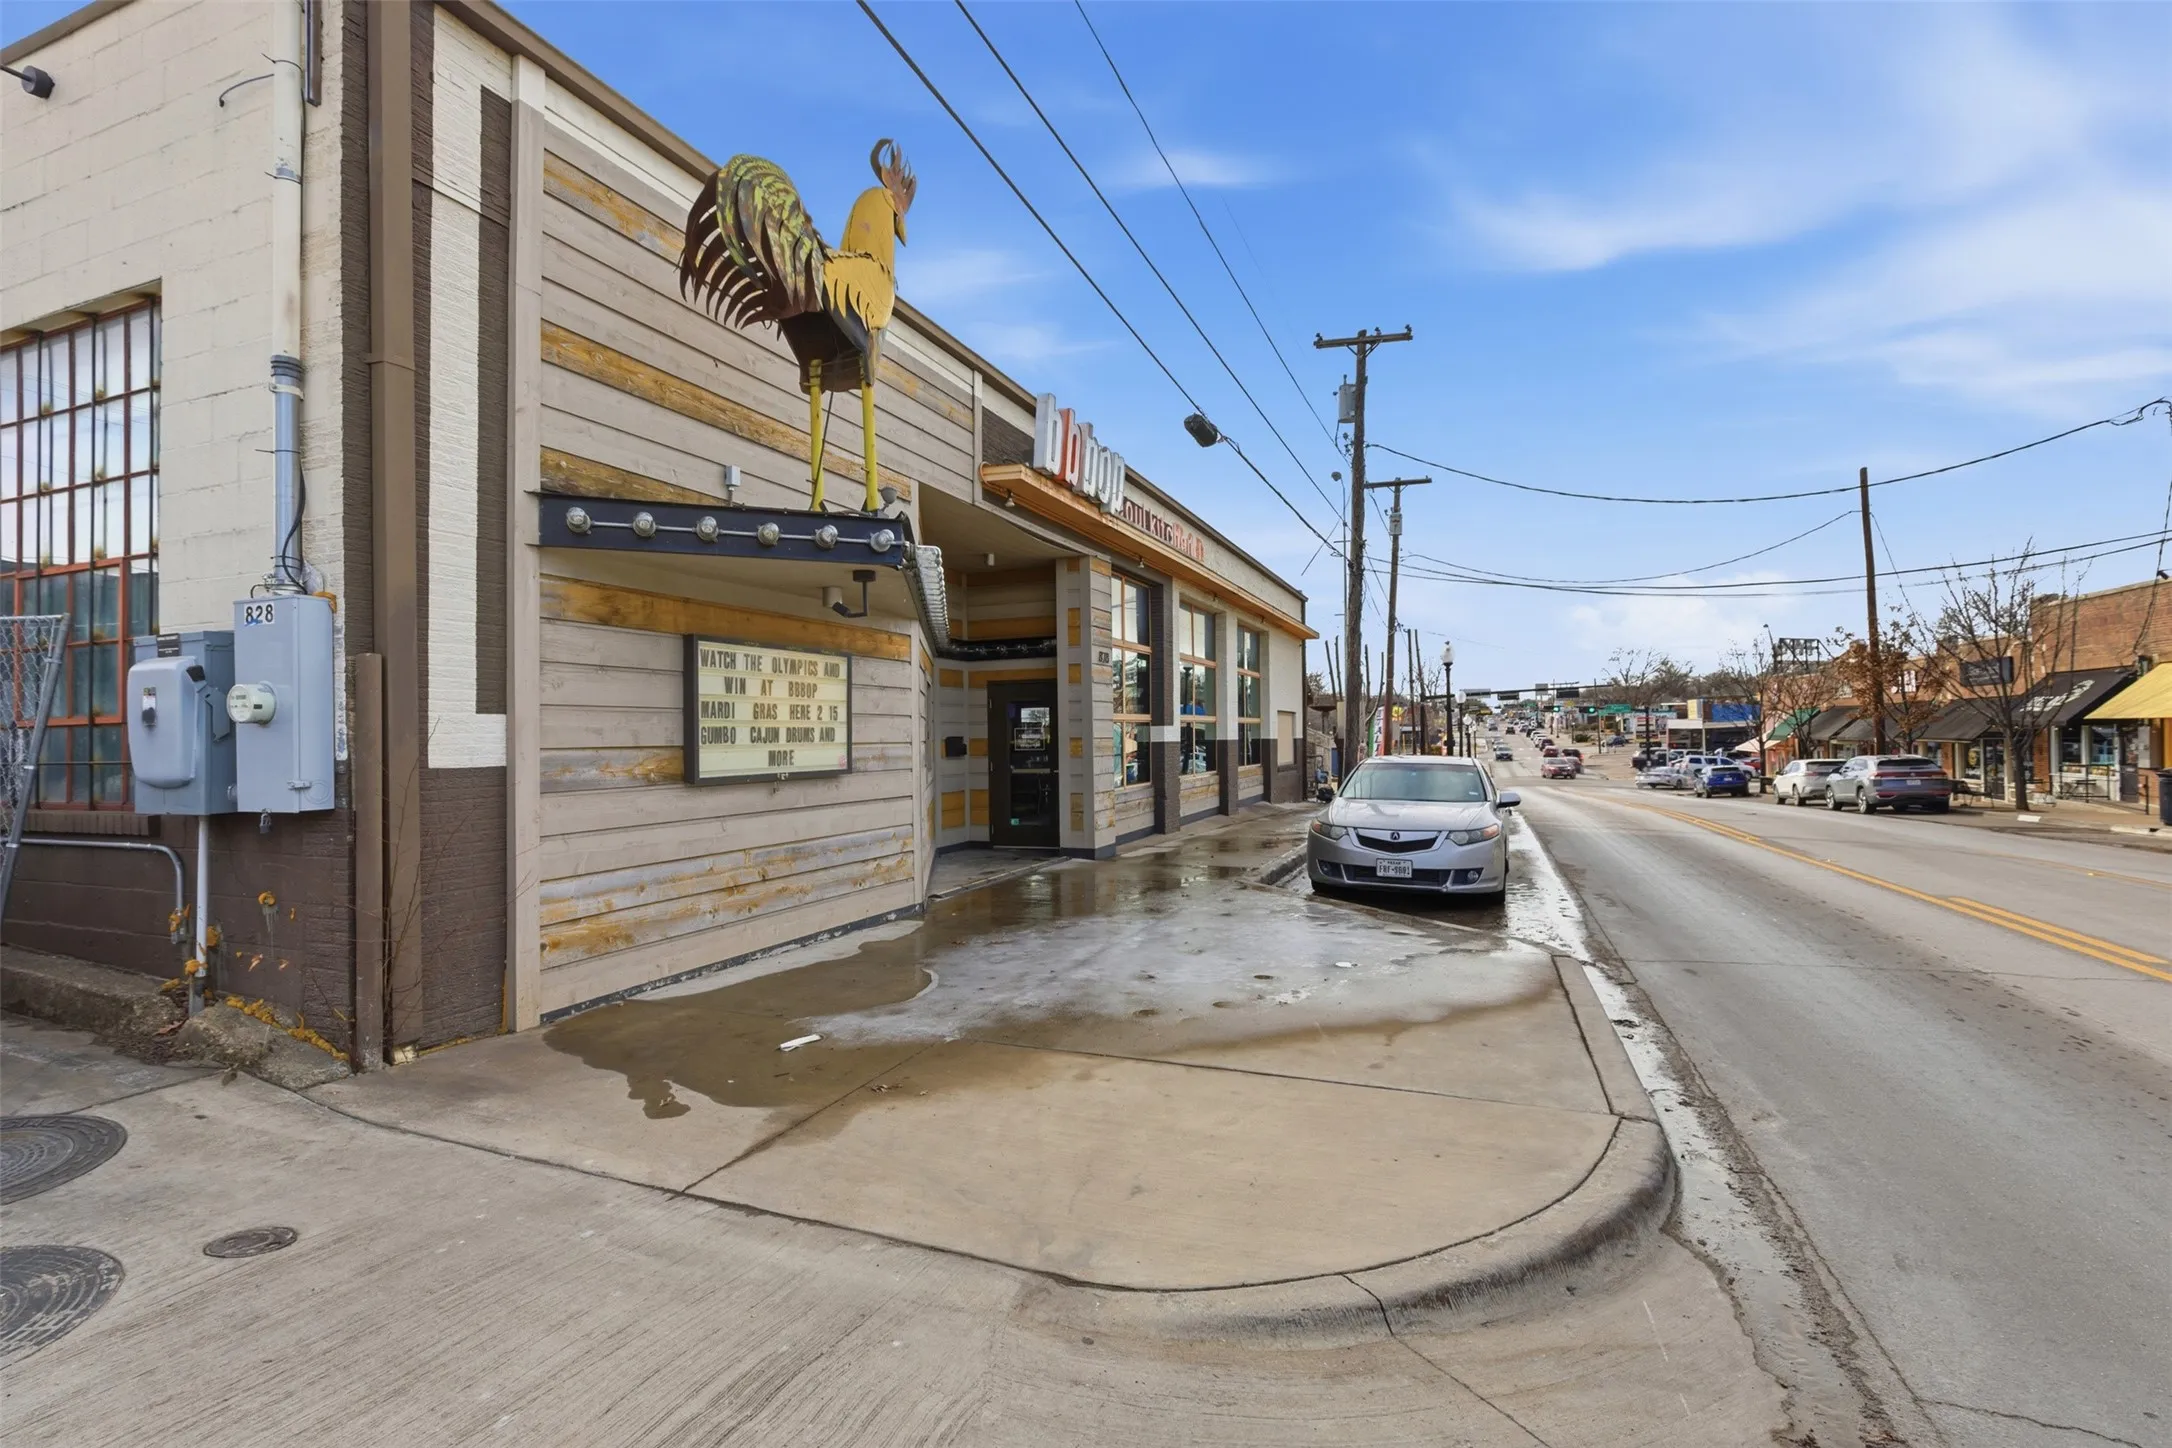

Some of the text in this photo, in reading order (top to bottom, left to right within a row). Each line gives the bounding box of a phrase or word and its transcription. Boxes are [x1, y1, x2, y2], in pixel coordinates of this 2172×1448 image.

[246, 604, 273, 625] 828
[701, 648, 840, 678] WATCH THE OLYMPICS AND
[724, 676, 746, 695] WIN
[760, 679, 774, 696] AT
[700, 701, 838, 721] MARDI GRAS HERE 2 15
[700, 726, 836, 745] GUMBO CAJUN DRUMS AND
[768, 750, 794, 767] MORE
